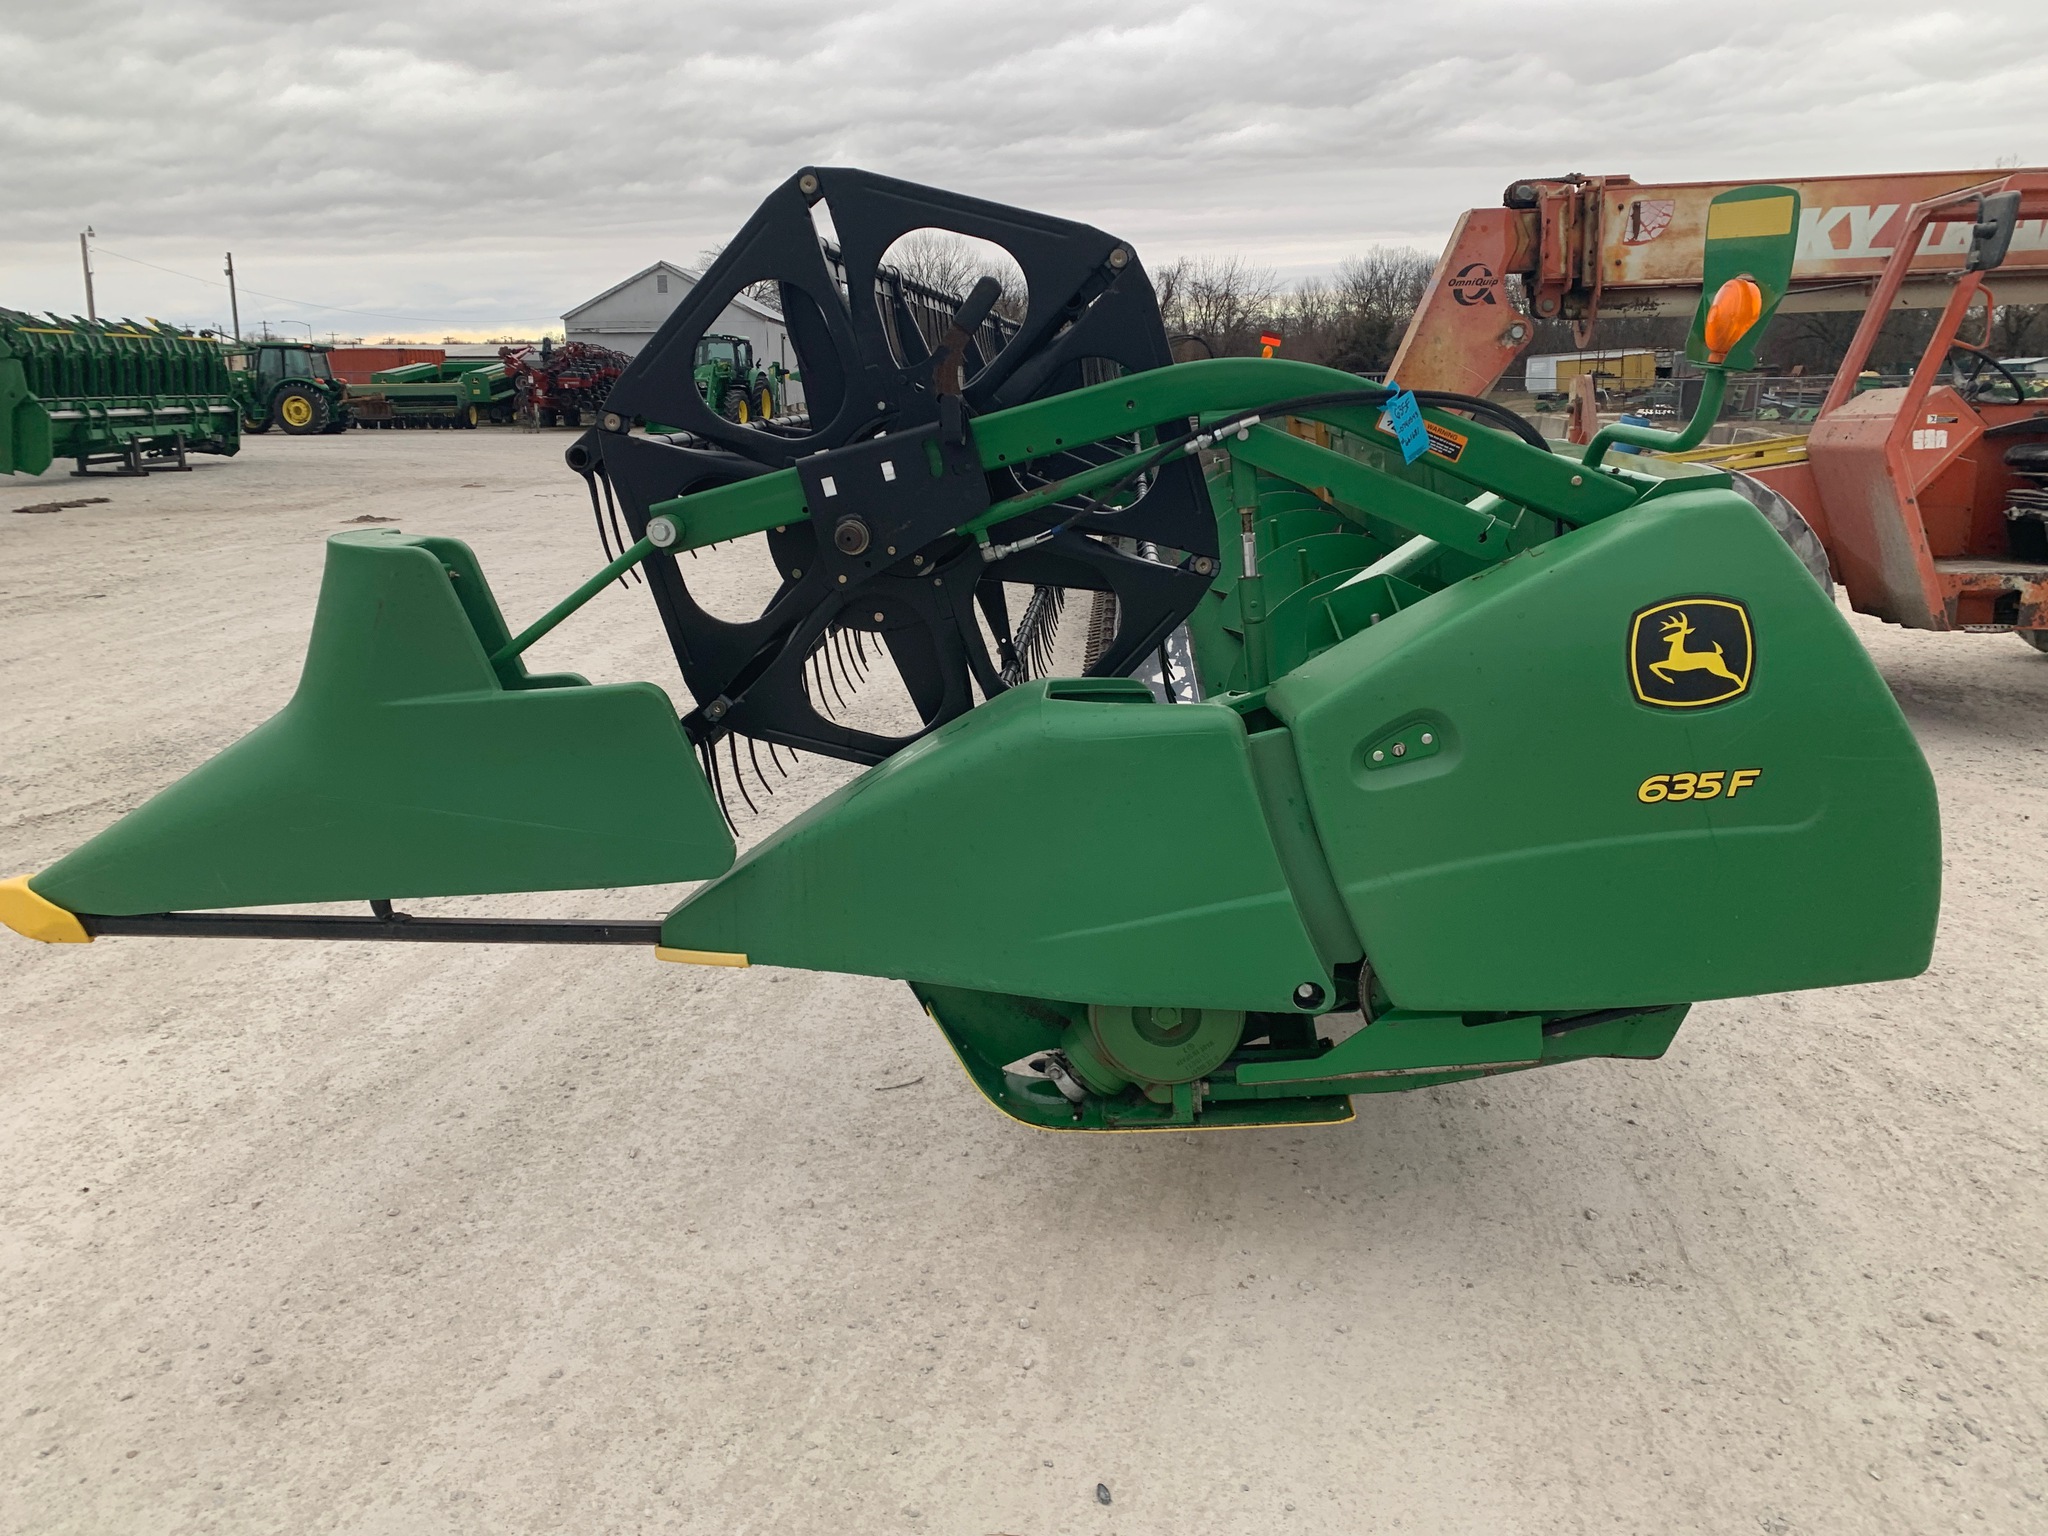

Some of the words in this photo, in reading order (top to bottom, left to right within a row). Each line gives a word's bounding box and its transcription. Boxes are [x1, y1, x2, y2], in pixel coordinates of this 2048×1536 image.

[1795, 203, 1899, 260] KY
[1448, 277, 1499, 287] OmniQuip
[1427, 423, 1458, 441] WARNING
